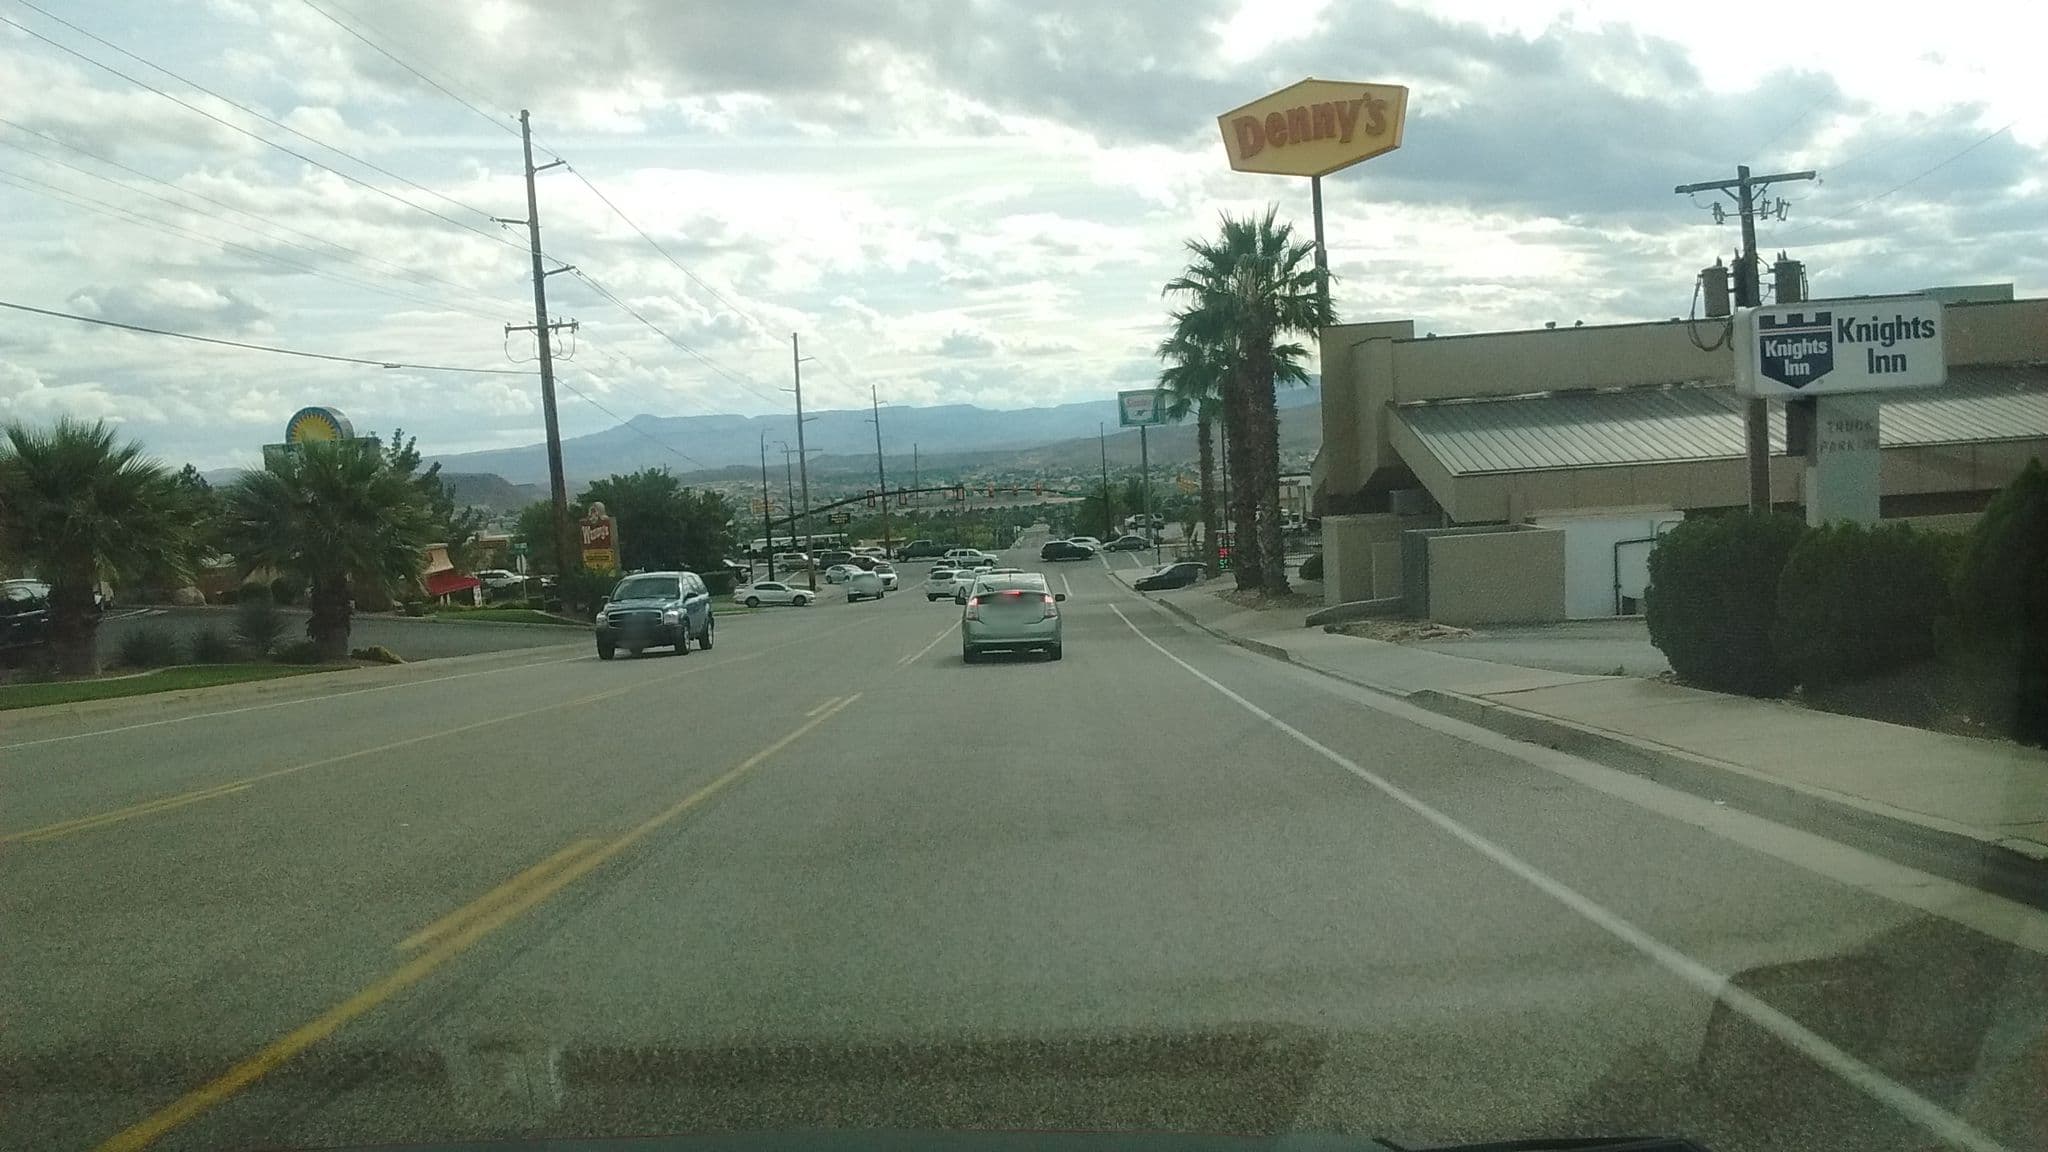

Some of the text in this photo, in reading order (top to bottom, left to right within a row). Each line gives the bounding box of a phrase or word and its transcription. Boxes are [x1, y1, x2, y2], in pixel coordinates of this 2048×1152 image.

[1231, 92, 1388, 160] Denny's
[1837, 314, 1936, 347] Knights
[1765, 338, 1828, 359] Knights
[1784, 359, 1811, 376] Inn
[1867, 348, 1907, 374] Inn
[1820, 439, 1876, 453] PARK
